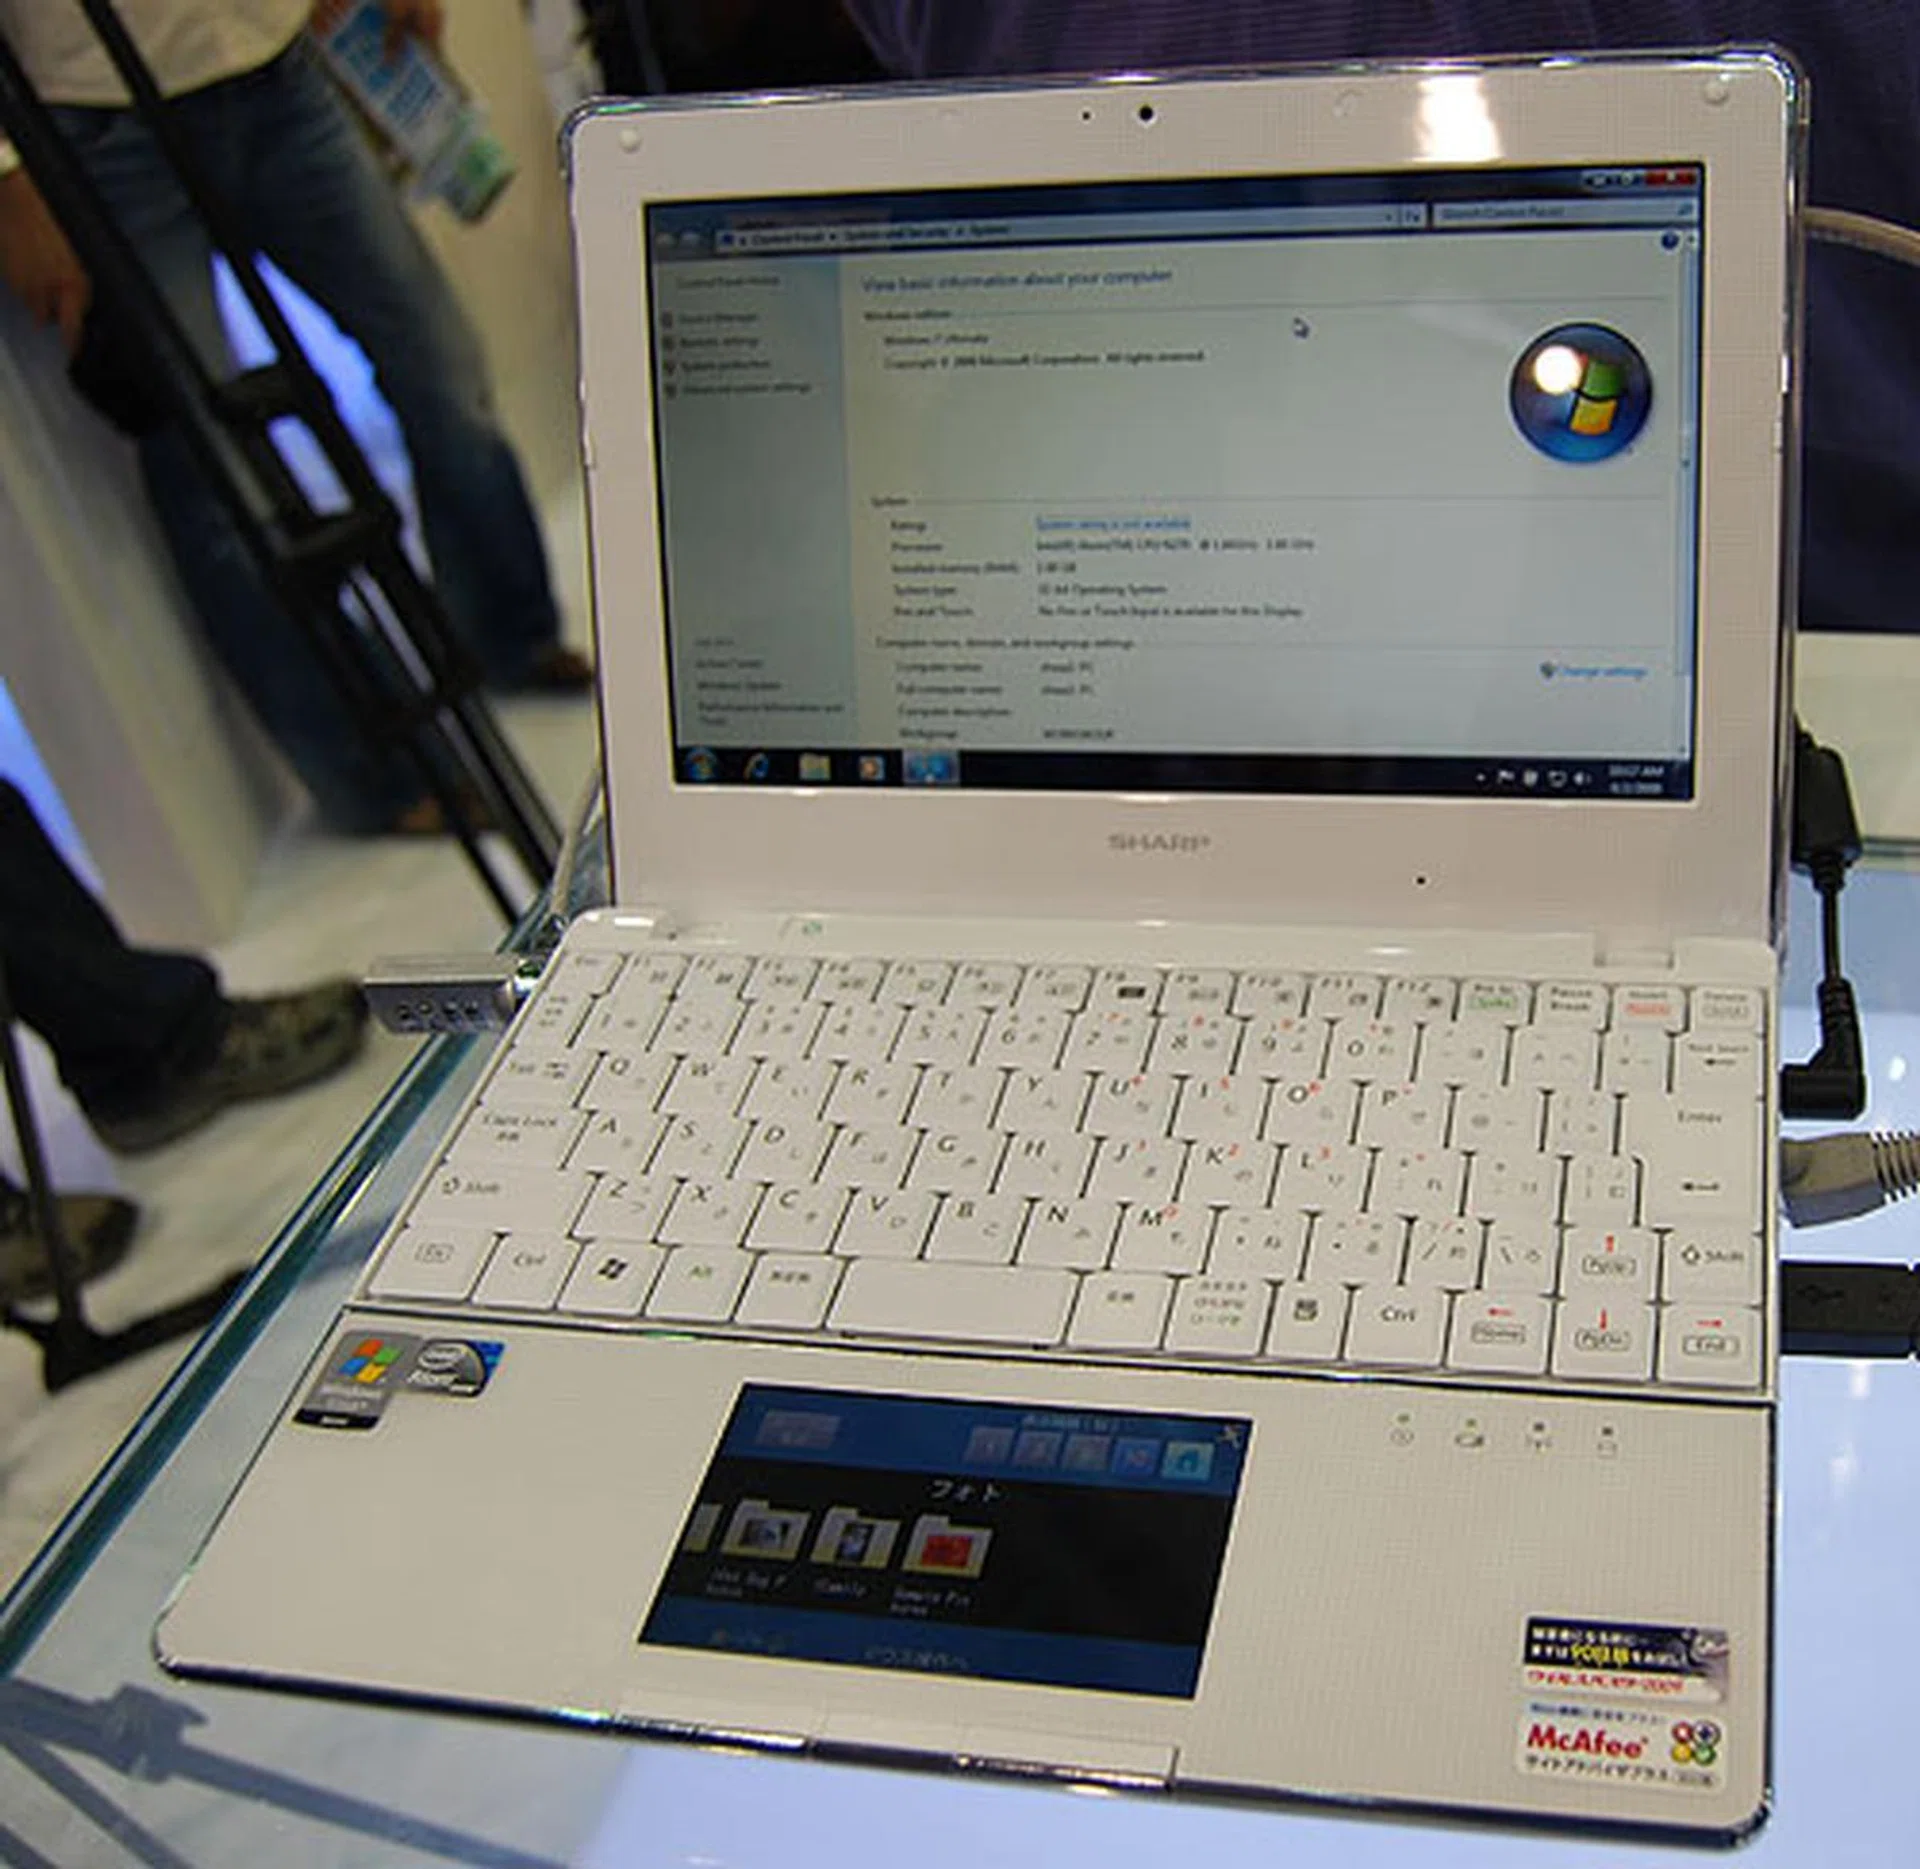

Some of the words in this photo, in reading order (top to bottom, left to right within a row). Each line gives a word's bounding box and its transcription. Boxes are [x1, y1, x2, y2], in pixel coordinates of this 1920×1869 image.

[1024, 270, 1065, 286] about
[1102, 268, 1173, 287] computer
[1107, 832, 1212, 852] SHARP
[608, 1057, 631, 1077] Q
[1108, 1078, 1130, 1097] U
[1287, 1084, 1309, 1104] O
[1381, 1088, 1399, 1106] P
[598, 1116, 618, 1134] A
[678, 1120, 697, 1139] S
[762, 1123, 786, 1145] D
[936, 1133, 960, 1154] G
[1023, 1139, 1047, 1158] H
[1113, 1143, 1131, 1163] J
[1204, 1147, 1224, 1166] K
[608, 1178, 630, 1199] Z
[691, 1184, 714, 1203] X
[778, 1187, 802, 1210] C
[868, 1195, 891, 1213] V
[956, 1201, 976, 1219] B
[1046, 1205, 1070, 1225] N
[1138, 1207, 1164, 1227] M
[1380, 1305, 1416, 1323] Ctrl
[1527, 1722, 1643, 1760] McAfee
